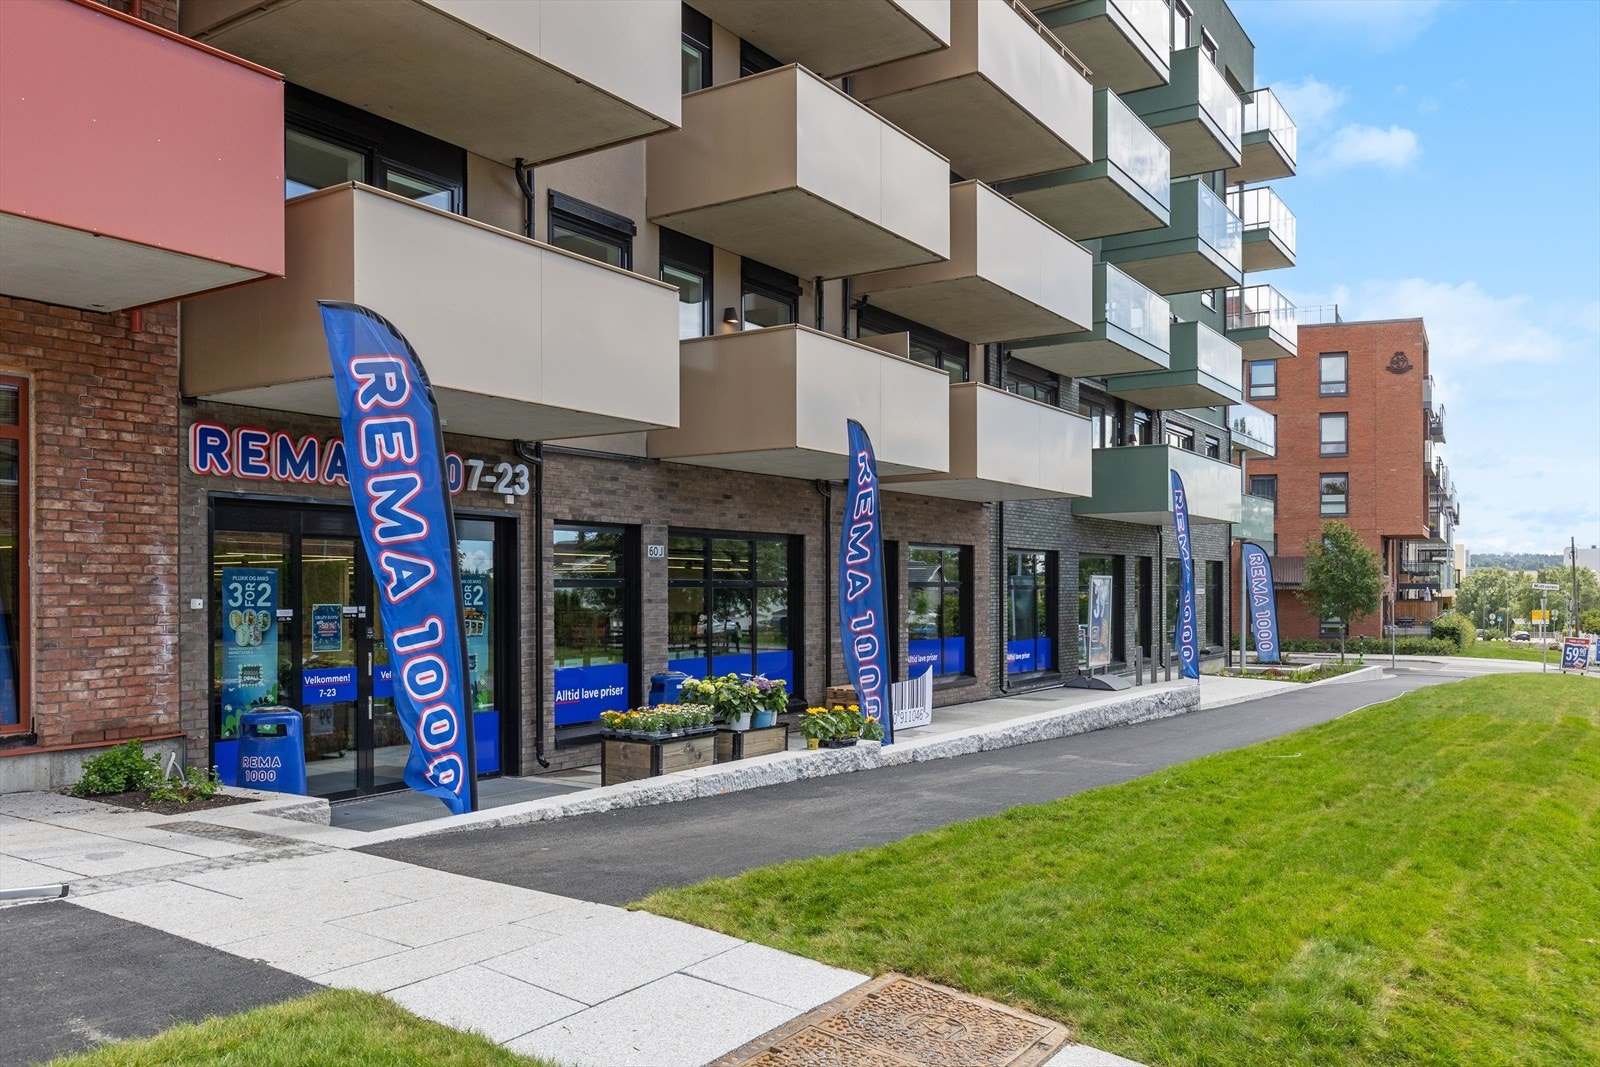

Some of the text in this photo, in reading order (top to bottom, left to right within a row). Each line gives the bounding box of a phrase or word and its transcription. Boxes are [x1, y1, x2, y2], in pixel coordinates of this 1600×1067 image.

[189, 421, 350, 487] REMA
[466, 459, 530, 496] 7-23
[350, 354, 464, 796] REMA 1000
[228, 582, 272, 607] 3 FOR 2
[464, 585, 484, 606] FOR 2
[1249, 553, 1274, 652] REMA 1000
[304, 673, 351, 685] Velkommen!
[319, 688, 337, 698] 7-23
[556, 685, 624, 702] Alltid lave priser
[242, 756, 282, 768] REMA
[245, 770, 277, 782] 1000
